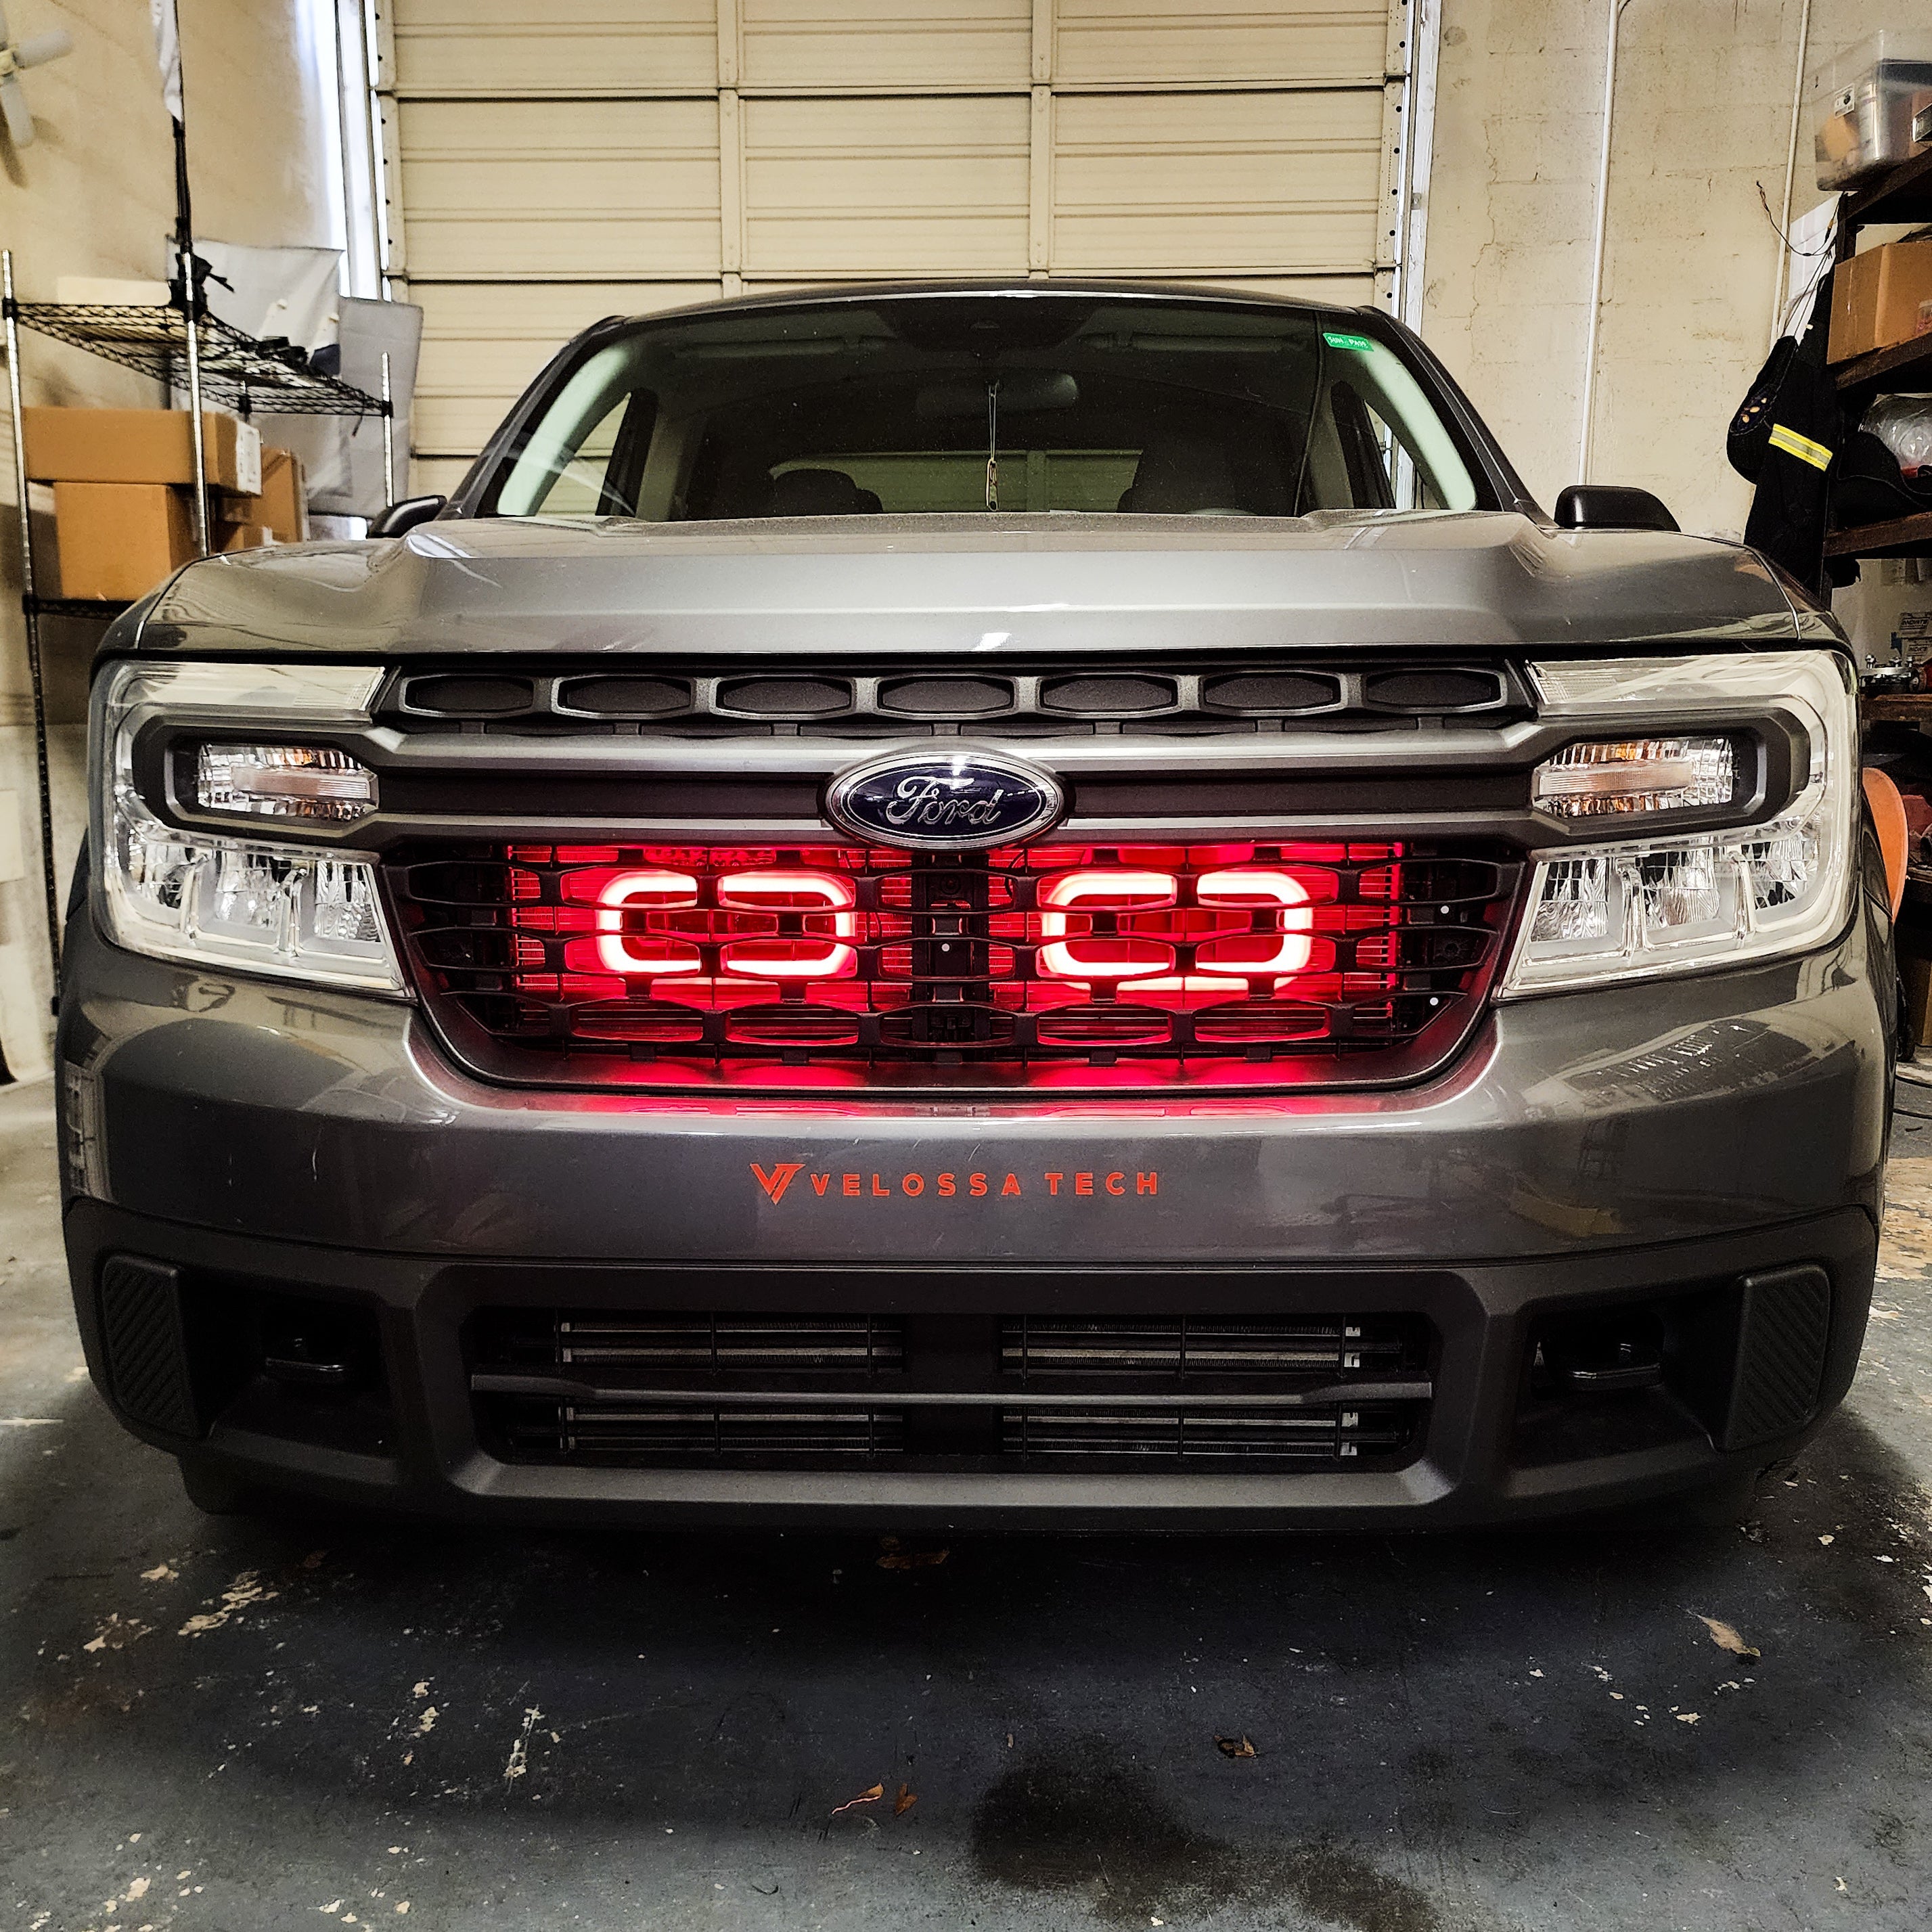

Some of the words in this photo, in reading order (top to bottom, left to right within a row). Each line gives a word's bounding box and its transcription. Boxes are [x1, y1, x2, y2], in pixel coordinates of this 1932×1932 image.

[885, 776, 1004, 825] Ford
[810, 1172, 1021, 1197] VELOSSA
[1044, 1171, 1158, 1196] TECH
